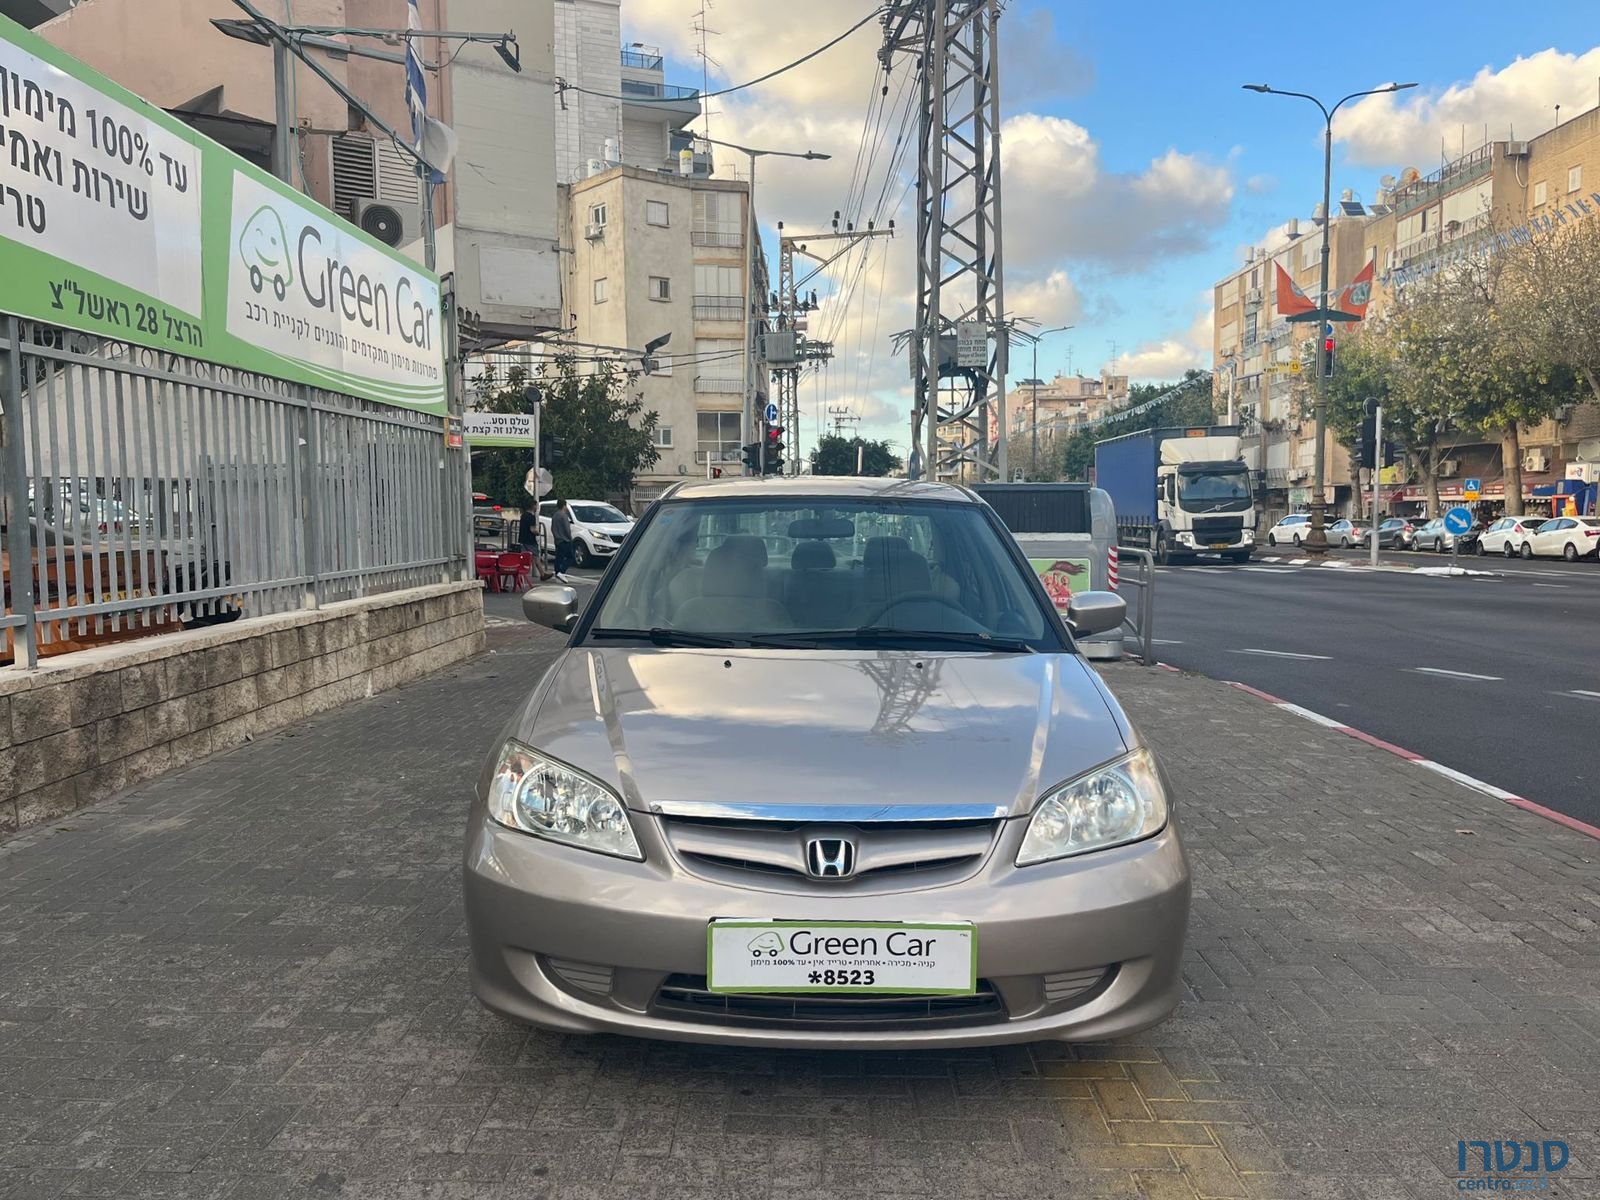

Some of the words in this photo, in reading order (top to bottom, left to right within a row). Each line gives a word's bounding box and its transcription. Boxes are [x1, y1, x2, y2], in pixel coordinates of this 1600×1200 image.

[86, 109, 154, 177] 100%
[159, 152, 188, 193] עד
[72, 158, 148, 221] שירות
[297, 225, 390, 335] Green
[396, 276, 434, 350] Car
[135, 303, 158, 335] 28
[245, 300, 269, 325] רכב
[273, 311, 310, 340] לקניית
[162, 309, 203, 347] הרצל
[314, 324, 348, 352] והוגנים
[351, 338, 389, 365] מתקדמים
[391, 351, 411, 370] מימון
[472, 426, 491, 435] קצת
[493, 426, 503, 434] זה
[505, 426, 530, 435] אצלנו
[510, 417, 529, 426] שלם
[790, 931, 878, 957] Green
[886, 931, 936, 957] Car
[918, 960, 936, 968] קניה
